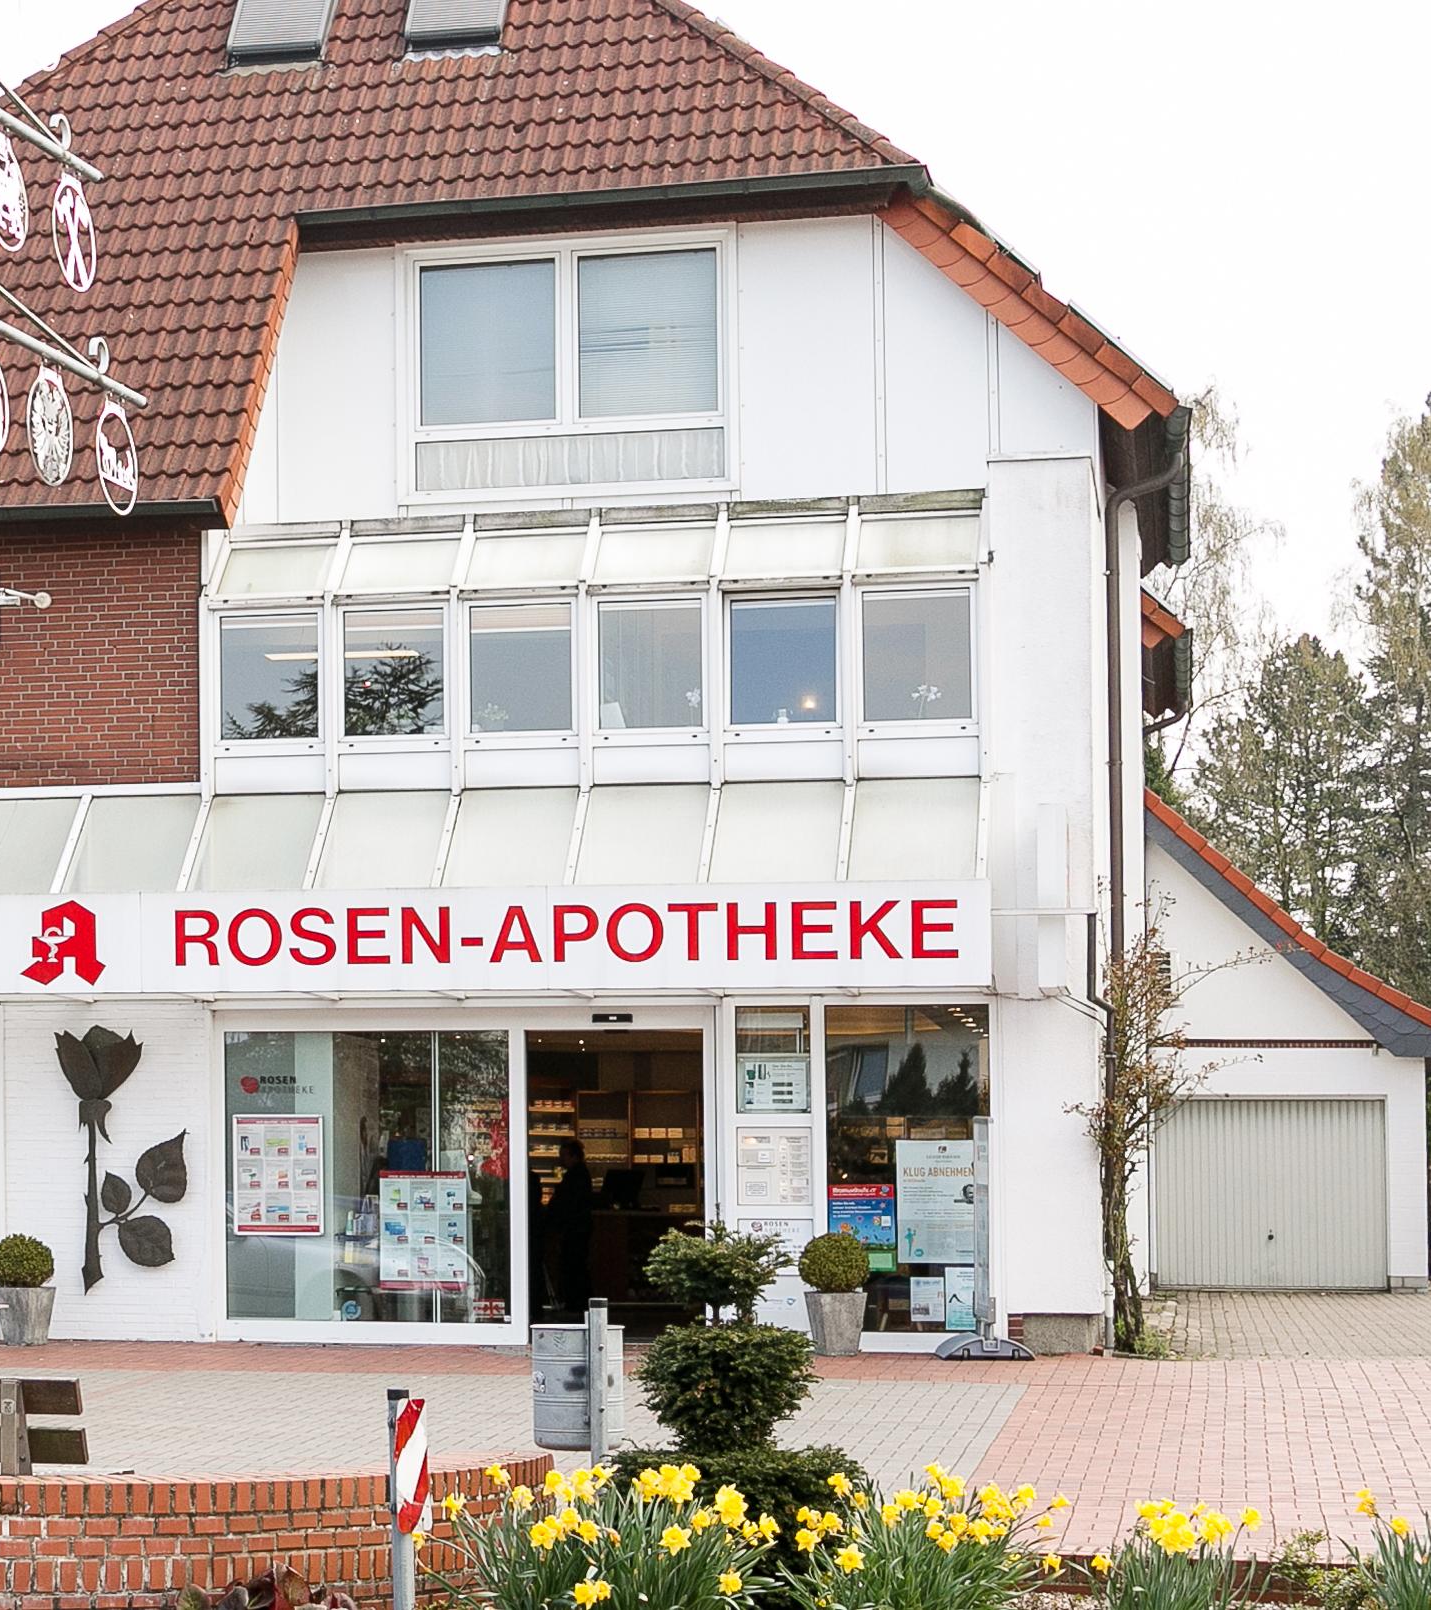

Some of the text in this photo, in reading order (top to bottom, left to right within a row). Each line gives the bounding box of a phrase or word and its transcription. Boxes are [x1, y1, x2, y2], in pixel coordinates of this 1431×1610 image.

[173, 898, 961, 967] ROSEN-APOTHEKE
[259, 1075, 297, 1085] ROSEN
[260, 1085, 314, 1095] APOTHEKE
[903, 1167, 975, 1178] KLUG ABNEHMEN
